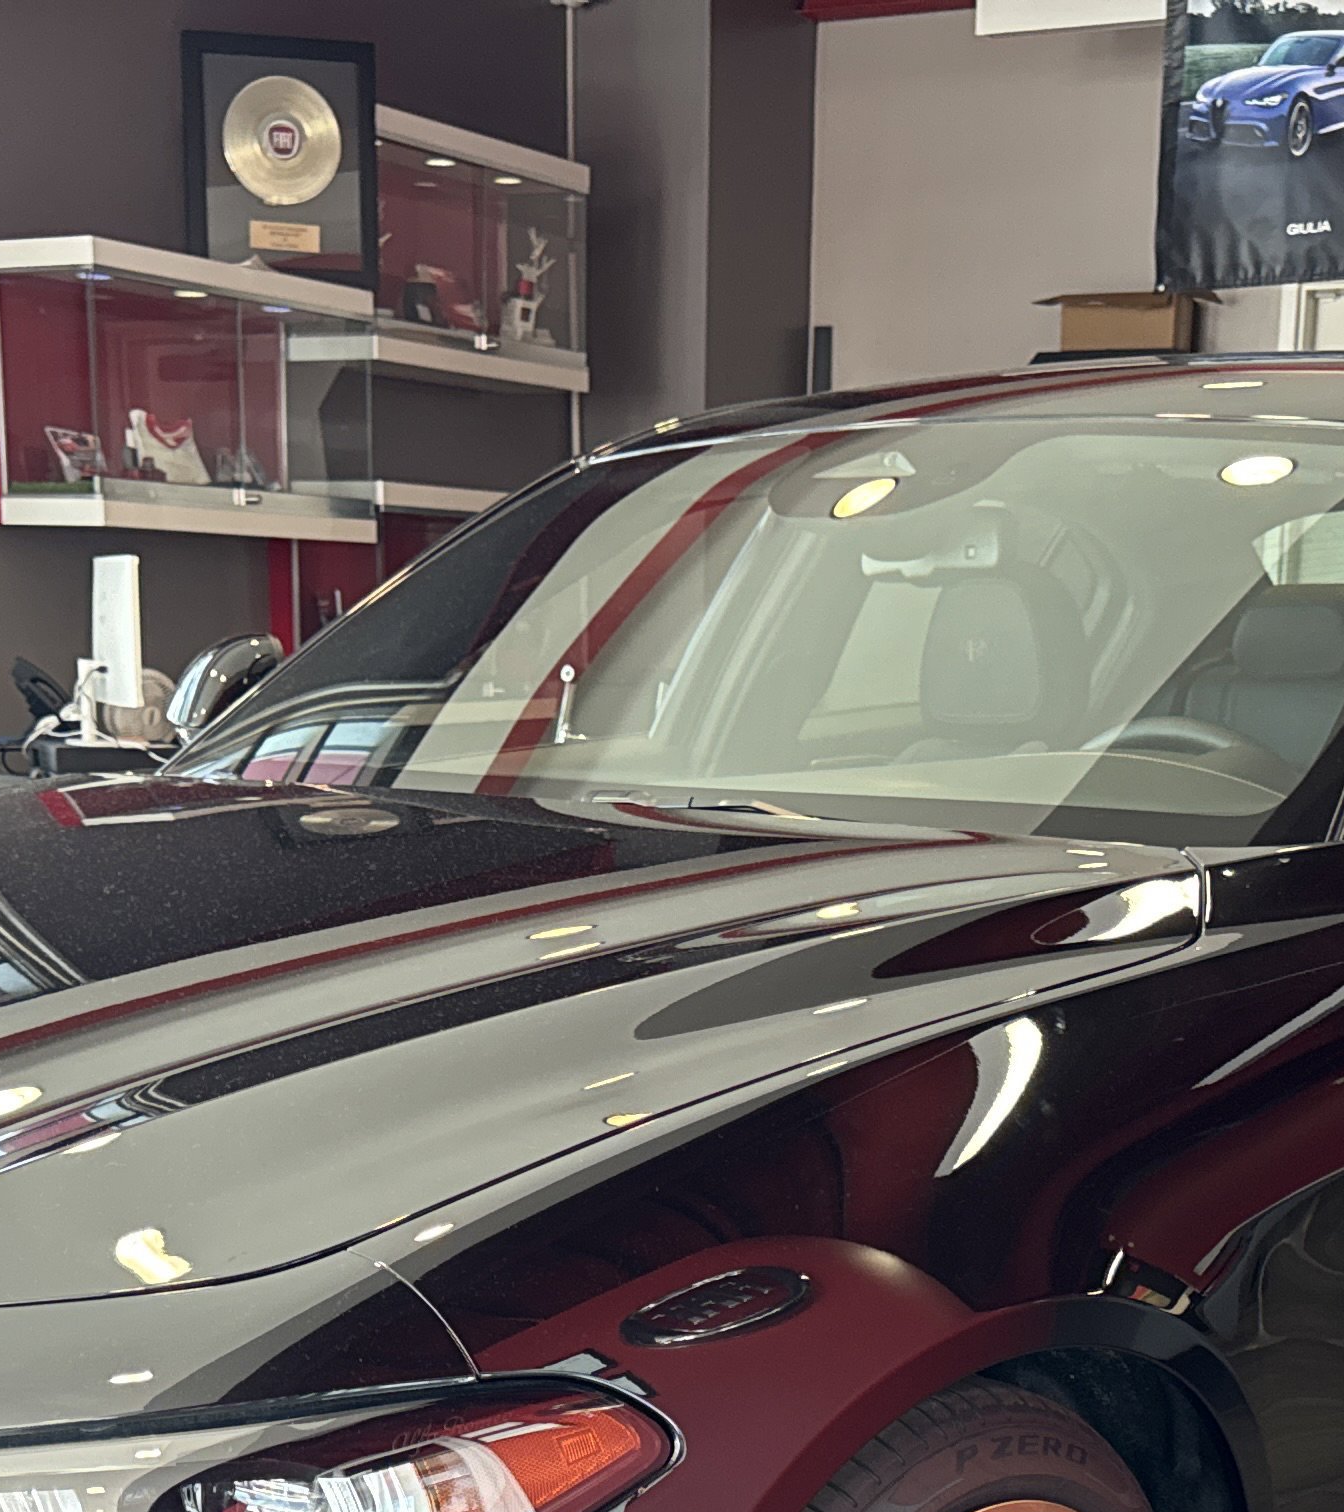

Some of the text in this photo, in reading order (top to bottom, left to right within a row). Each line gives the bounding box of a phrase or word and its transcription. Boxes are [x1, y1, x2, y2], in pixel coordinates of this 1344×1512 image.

[1286, 220, 1332, 236] GIULIA
[957, 1434, 1089, 1472] P ZERO
